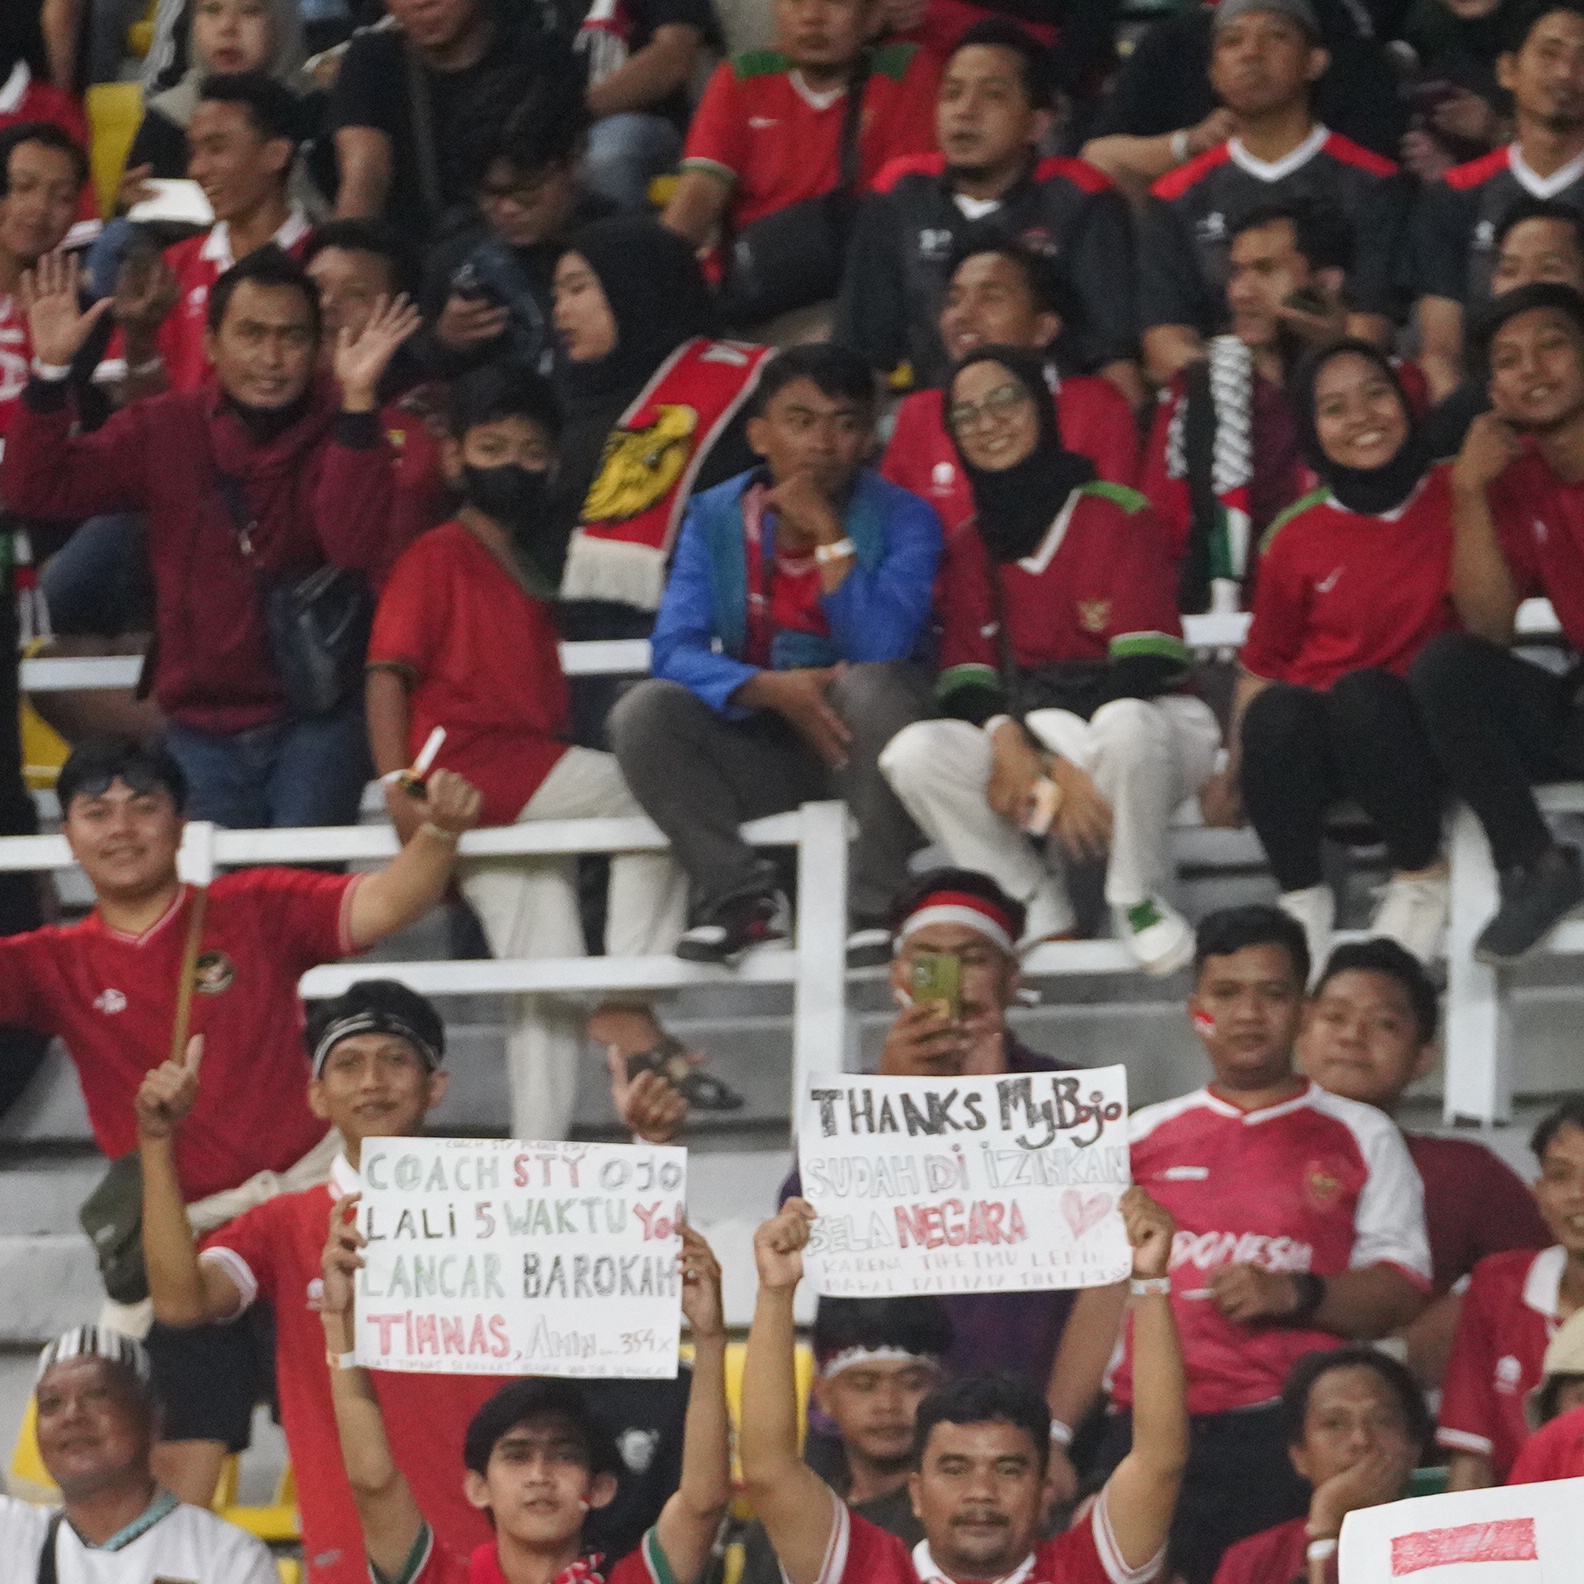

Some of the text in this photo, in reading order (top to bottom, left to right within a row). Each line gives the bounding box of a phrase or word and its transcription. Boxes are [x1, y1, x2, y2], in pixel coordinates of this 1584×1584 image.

[810, 1086, 987, 1138] THANKS
[366, 1151, 683, 1193] COACH STY OJO
[474, 1201, 496, 1240] 5
[503, 1197, 628, 1237] WAKTU
[894, 1198, 1029, 1250] NEGARA
[360, 1250, 679, 1299] LANCAR BAROKAH
